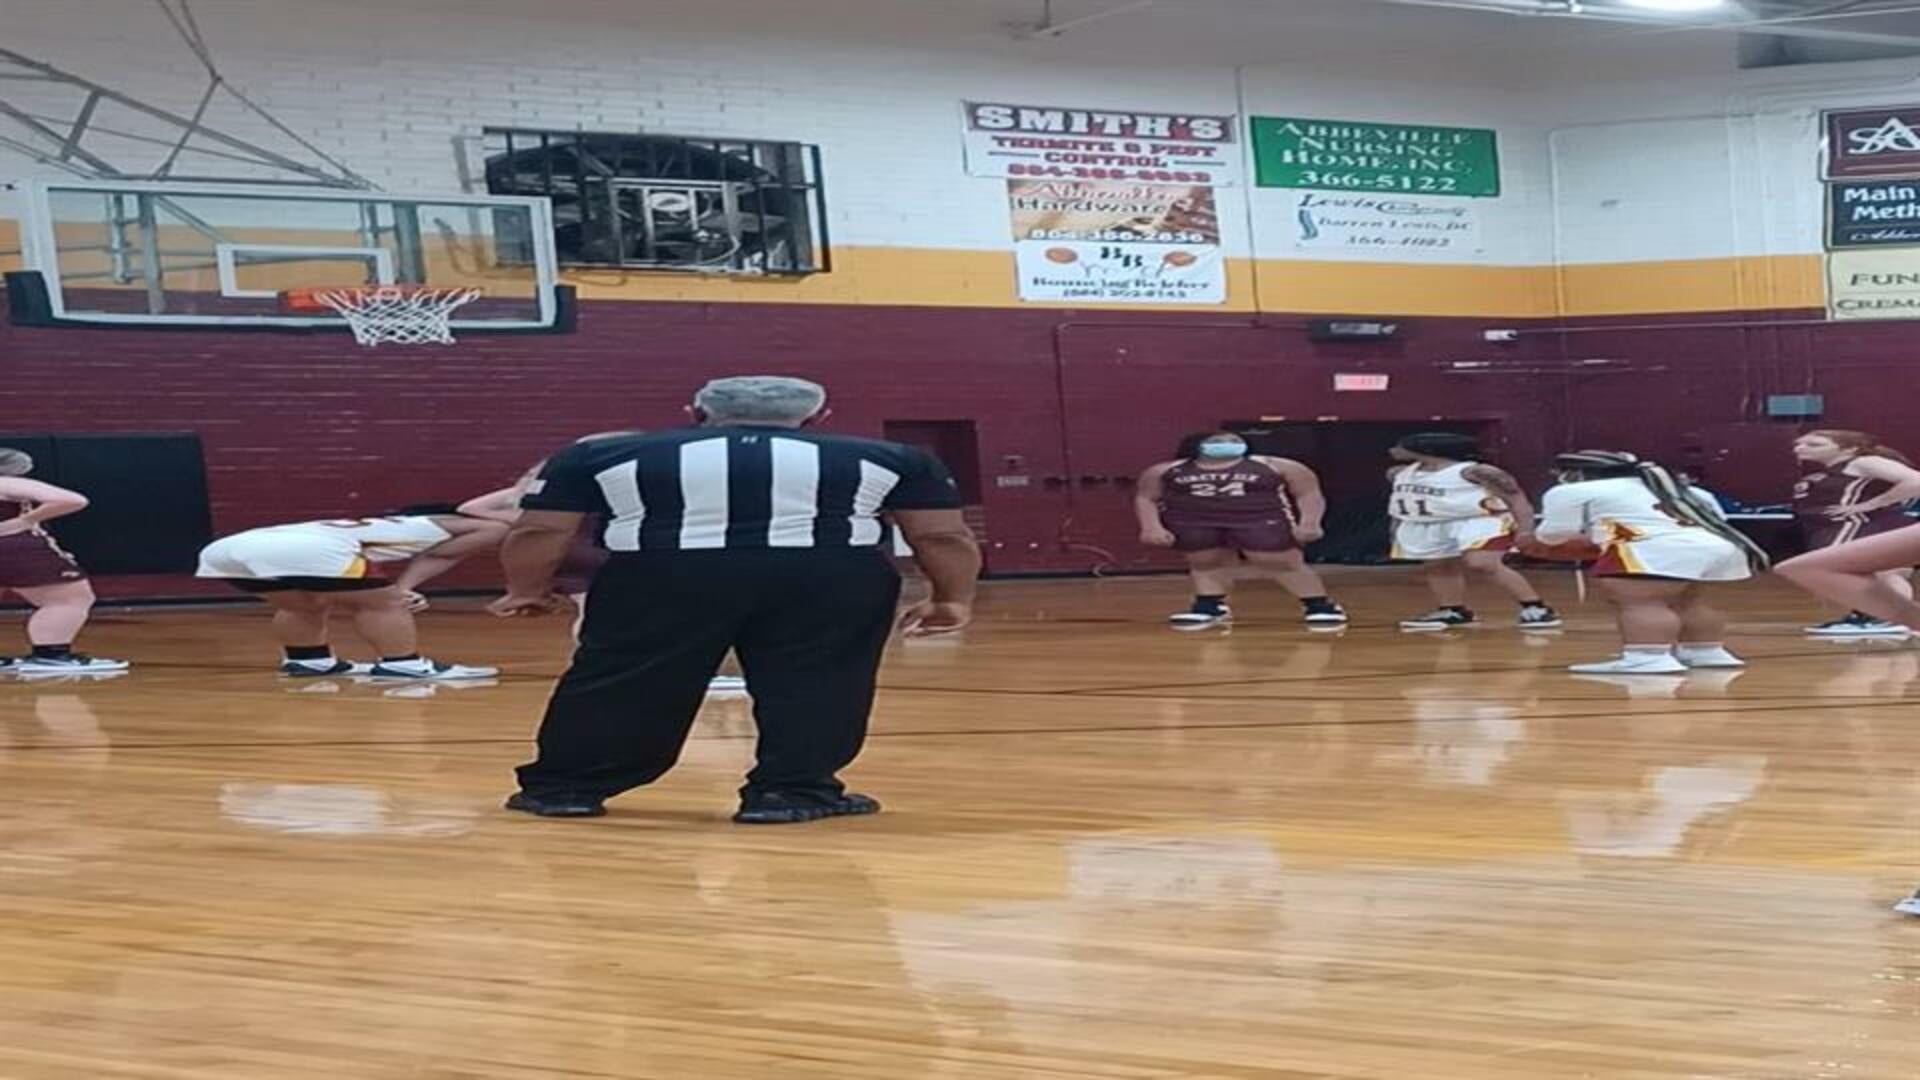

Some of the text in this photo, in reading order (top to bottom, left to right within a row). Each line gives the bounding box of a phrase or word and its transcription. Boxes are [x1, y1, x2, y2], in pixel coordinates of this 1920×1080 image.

[976, 105, 1223, 140] SMITH'S
[992, 136, 1115, 152] TERMITE
[1299, 137, 1454, 157] NURSING
[1044, 152, 1168, 168] CONTROL
[1297, 170, 1457, 191] 366-5122
[1843, 186, 1915, 203] Main
[1016, 197, 1171, 214] Hardware
[1836, 299, 1920, 311] CREM
[1190, 482, 1247, 497] 24
[1397, 499, 1433, 516] 11
